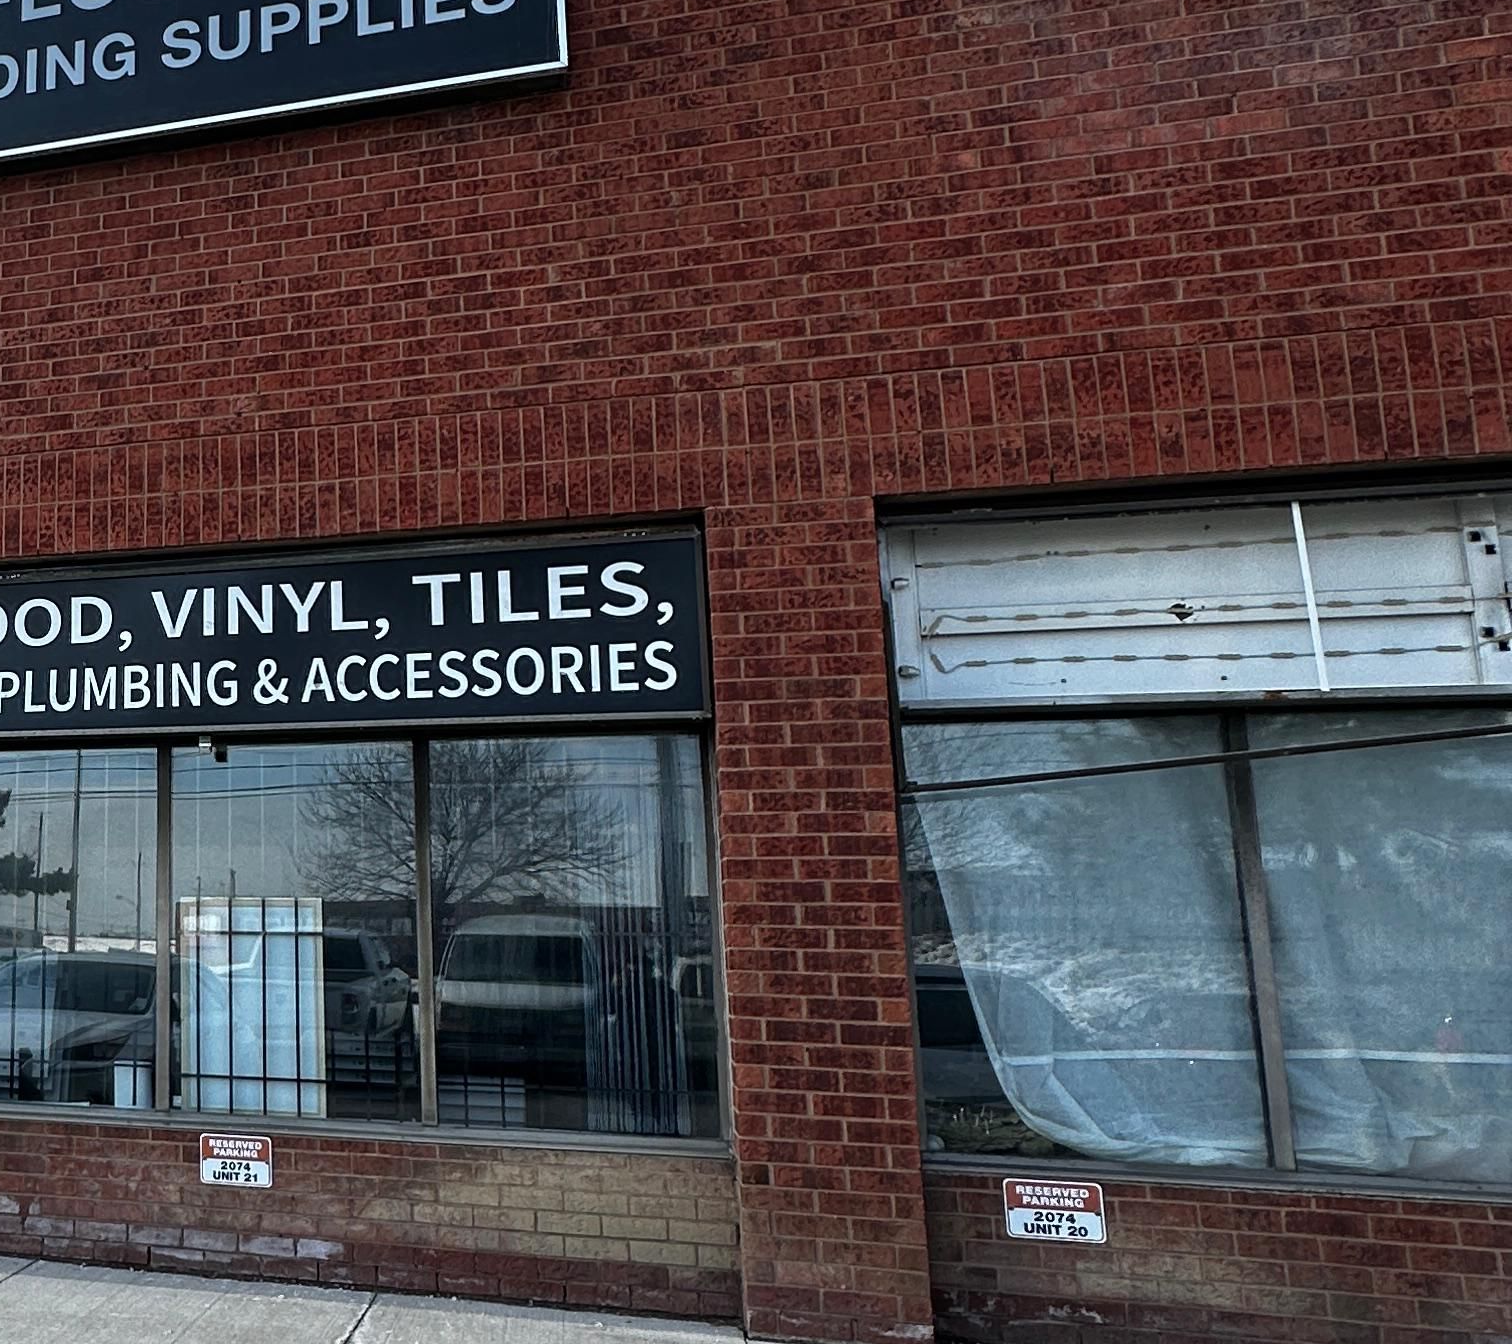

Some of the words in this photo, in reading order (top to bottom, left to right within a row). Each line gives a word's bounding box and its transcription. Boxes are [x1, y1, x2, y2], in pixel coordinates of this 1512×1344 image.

[151, 580, 390, 640] VINYL,
[411, 561, 674, 626] TILES,
[252, 658, 289, 705] &
[301, 641, 677, 704] ACCESSORIES
[208, 1138, 262, 1150] RESERVED
[213, 1147, 258, 1158] PARKING
[220, 1161, 251, 1171] 2074
[212, 1170, 240, 1181] UNIT
[243, 1173, 258, 1182] 21
[1015, 1185, 1089, 1199] RESERVED
[1022, 1196, 1085, 1208] PARKING
[1033, 1211, 1076, 1224] 2074
[1023, 1222, 1062, 1236] UNIT
[1067, 1225, 1089, 1237] 20
